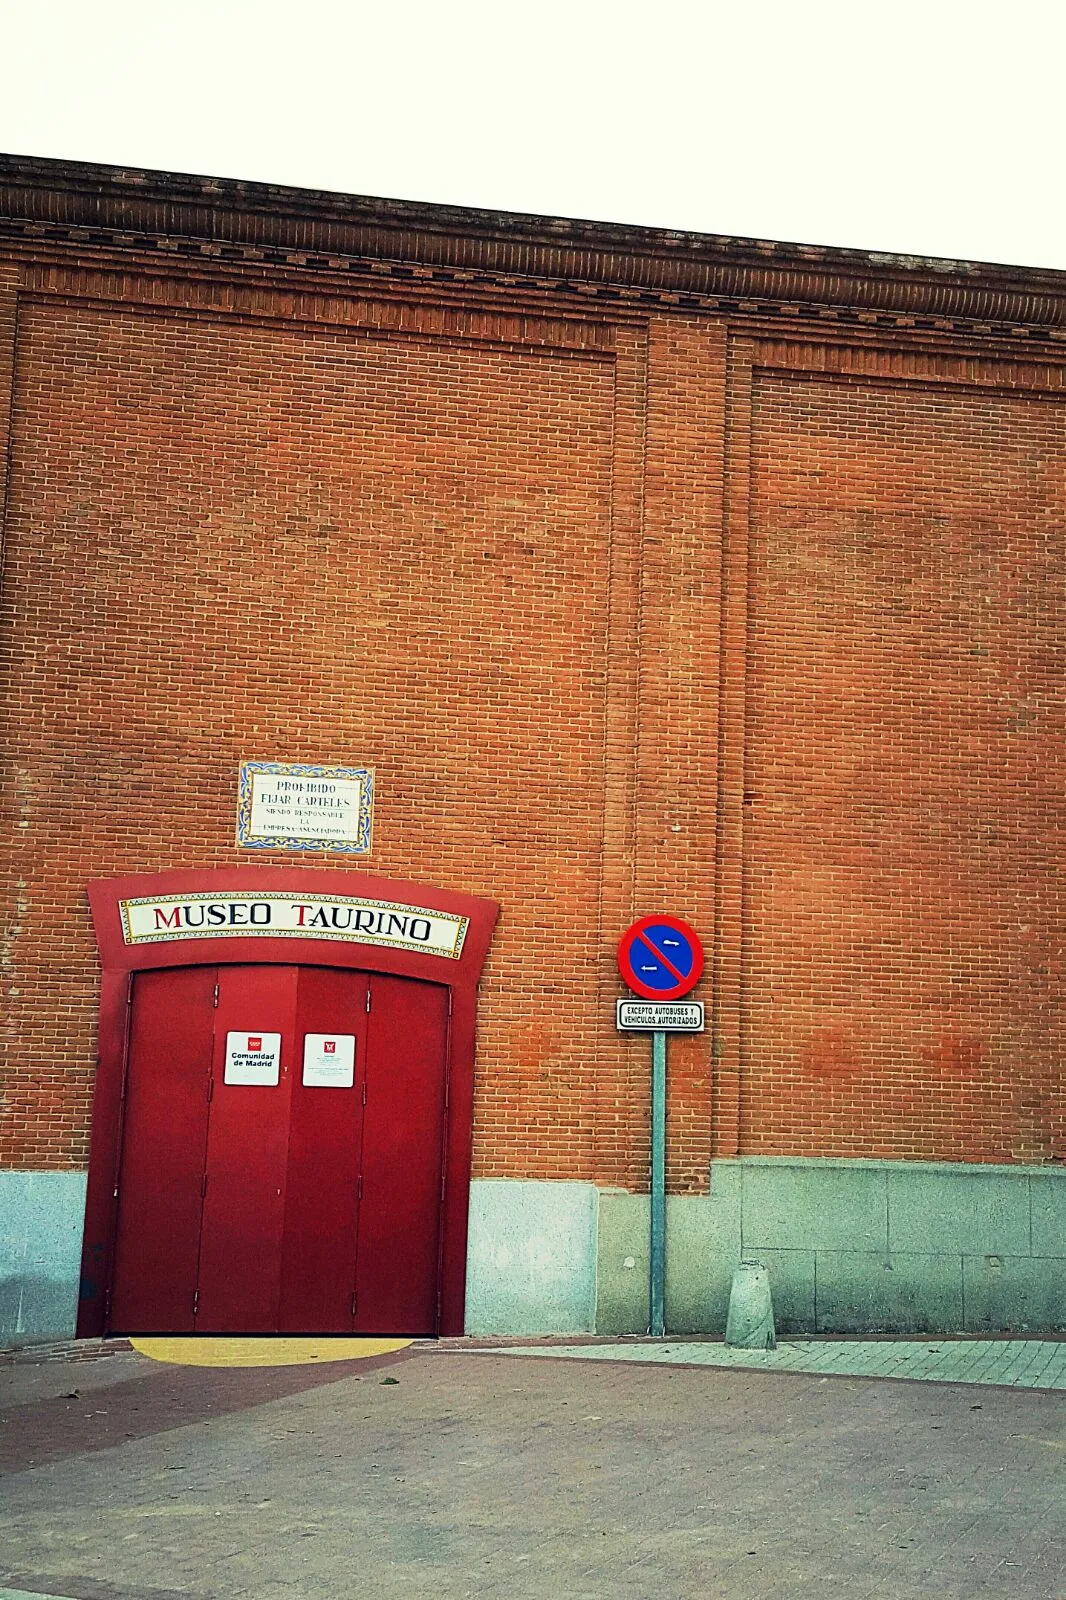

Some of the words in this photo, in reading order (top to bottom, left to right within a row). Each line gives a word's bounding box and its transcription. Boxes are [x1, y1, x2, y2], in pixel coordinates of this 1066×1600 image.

[277, 781, 336, 794] PROHIBIDO
[261, 794, 291, 805] FIJAR
[297, 796, 351, 808] CARTELES
[294, 809, 344, 819] RESPONSABLE
[153, 903, 271, 929] MUSEO
[291, 905, 432, 942] TAURINO
[627, 1006, 652, 1014] EXCEPTO
[655, 1007, 688, 1015] AUTOBUSES
[658, 1016, 697, 1025] AUTORIZADOS
[231, 1052, 275, 1060] Comunidad
